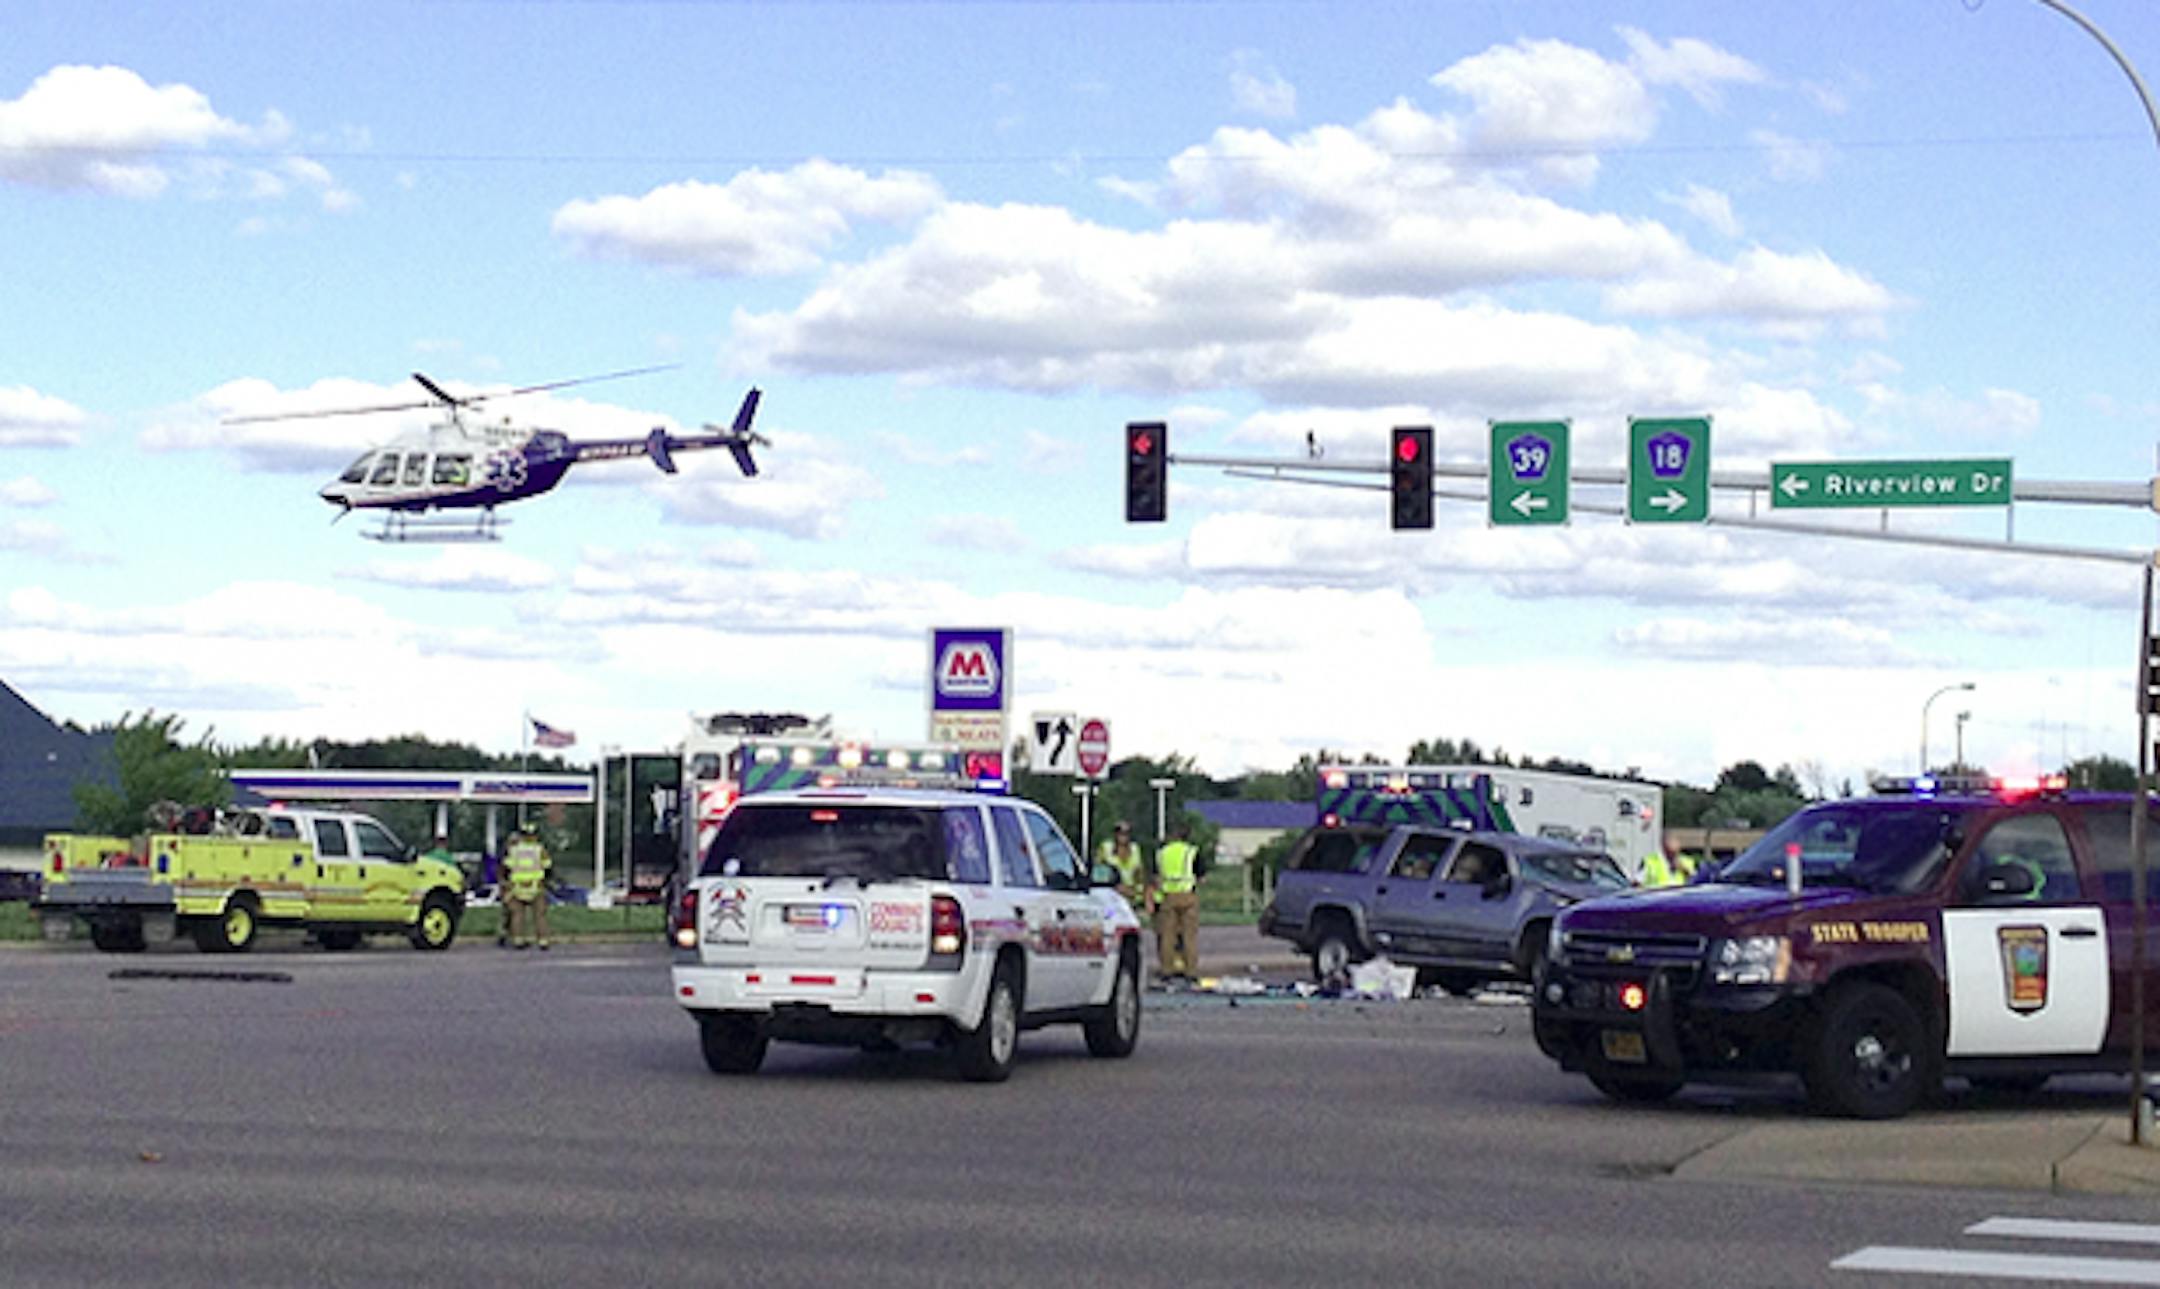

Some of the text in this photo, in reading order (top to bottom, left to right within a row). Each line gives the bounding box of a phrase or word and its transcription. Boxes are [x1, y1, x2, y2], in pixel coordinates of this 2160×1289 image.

[1514, 447, 1546, 472] 39
[1656, 444, 1683, 469] 18
[1823, 472, 2003, 495] Riverview Dr
[947, 651, 987, 676] M
[1811, 921, 1929, 943] STATE TROOPER
